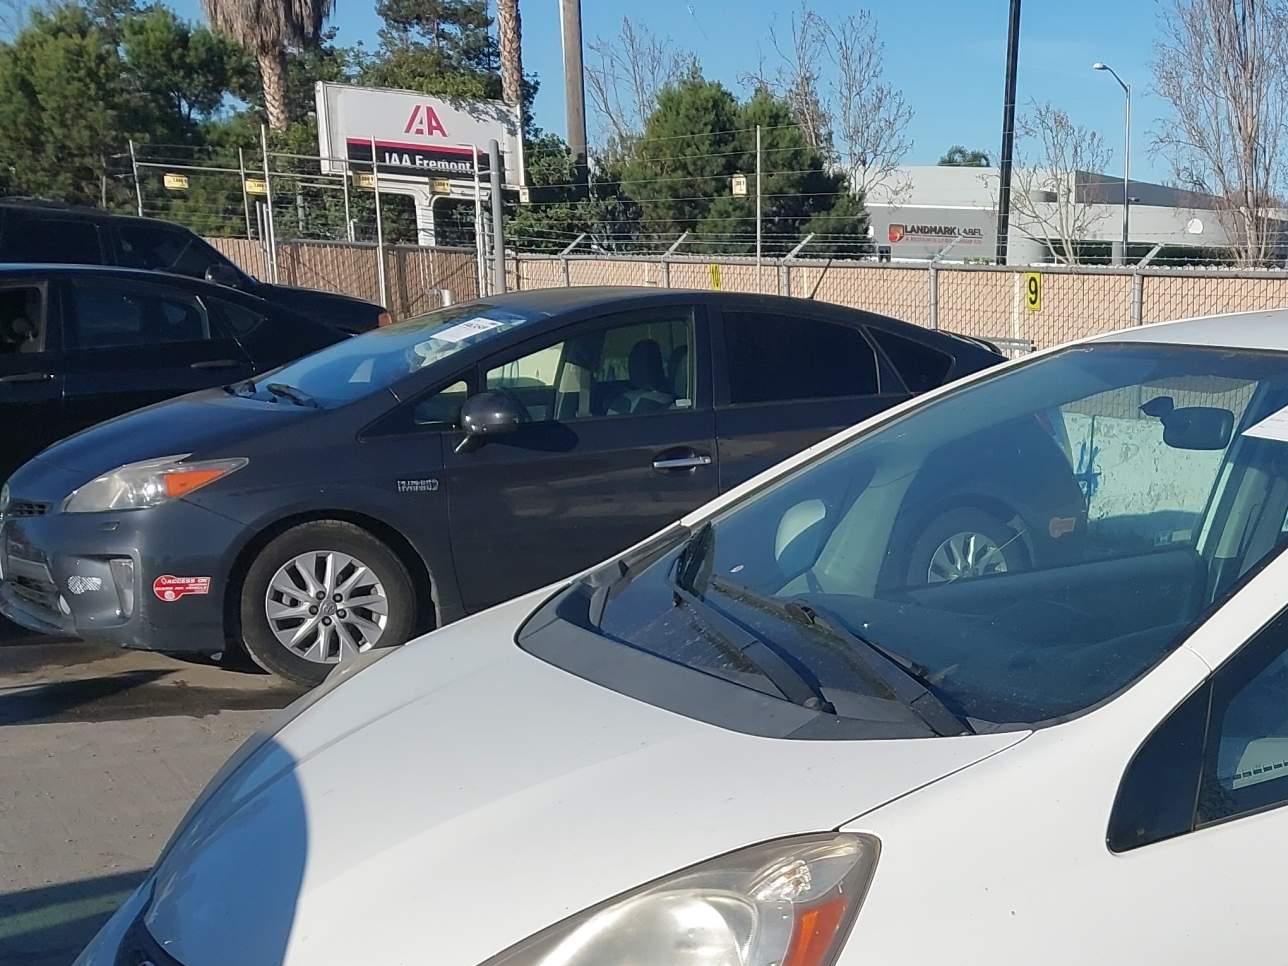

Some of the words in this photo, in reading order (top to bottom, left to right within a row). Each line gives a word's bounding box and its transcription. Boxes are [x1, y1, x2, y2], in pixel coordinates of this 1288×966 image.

[384, 151, 411, 168] IAA
[415, 155, 473, 174] Fremont
[904, 225, 956, 235] LANDMARK
[957, 228, 983, 236] LABEL
[1028, 276, 1038, 305] 9
